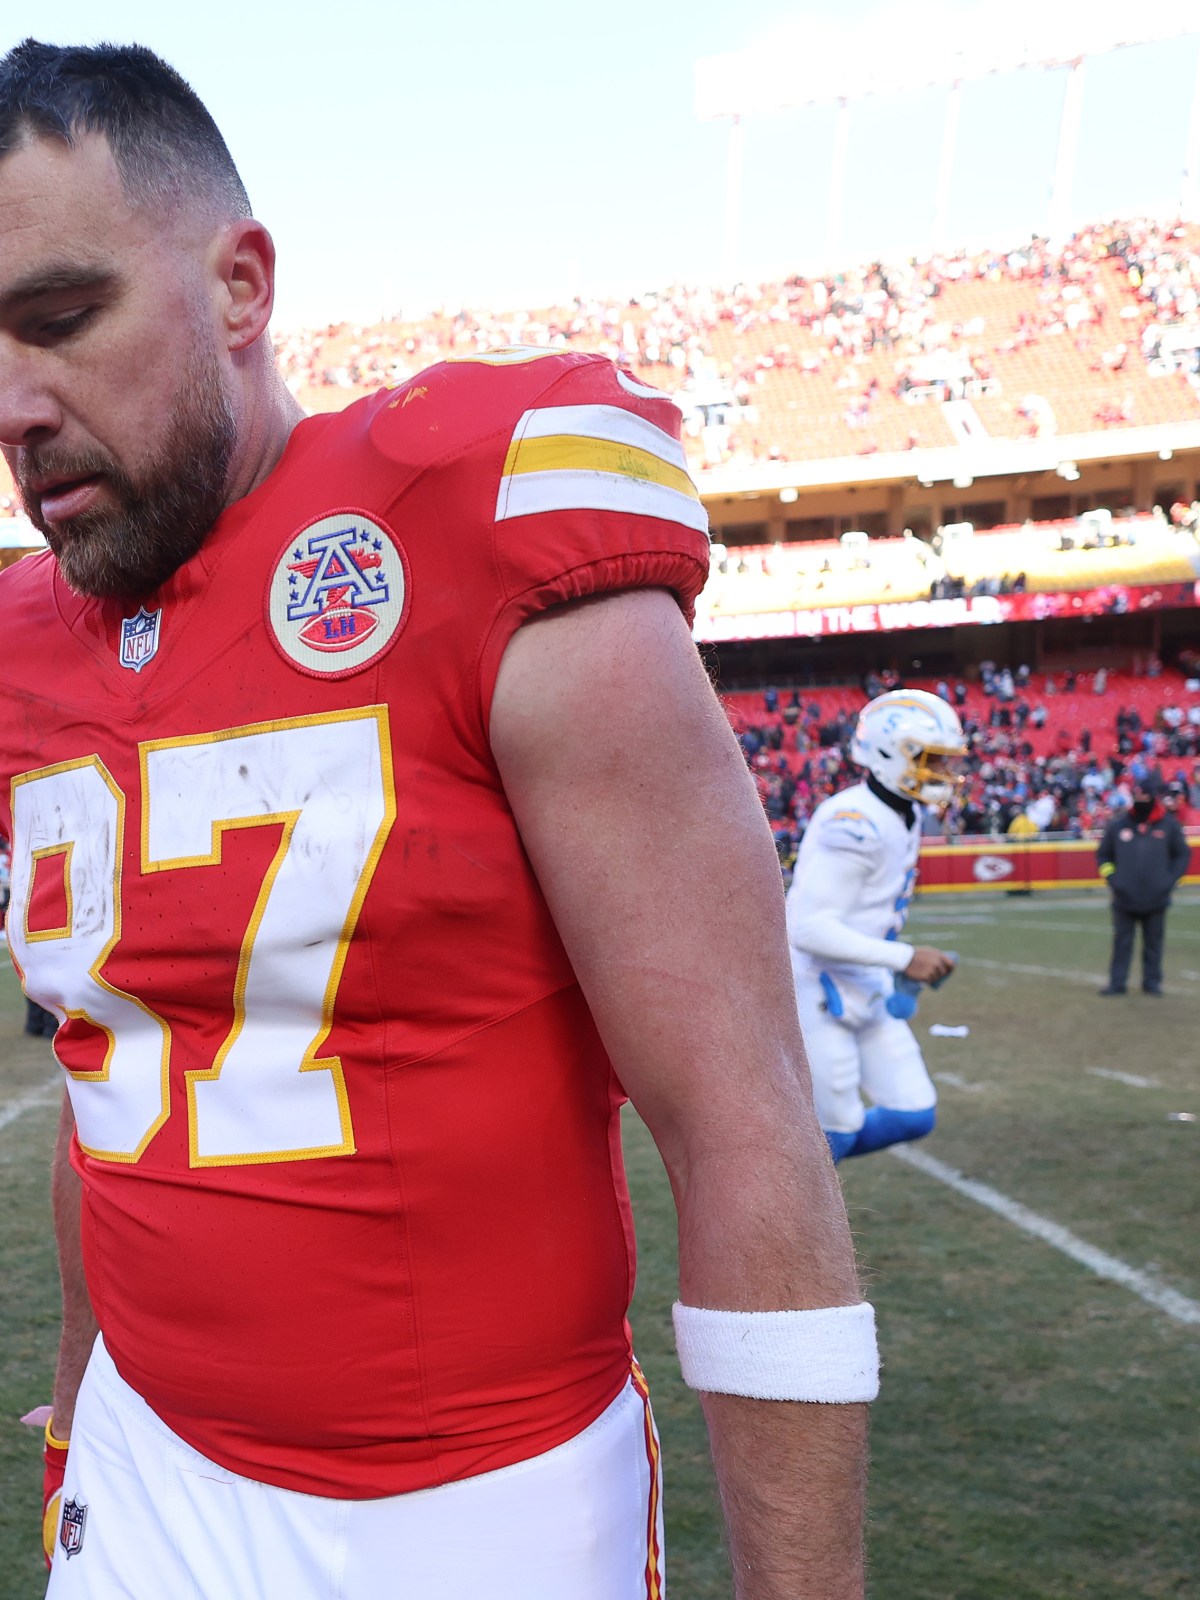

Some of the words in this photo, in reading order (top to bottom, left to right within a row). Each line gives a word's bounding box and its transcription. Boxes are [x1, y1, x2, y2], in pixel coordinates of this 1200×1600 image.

[322, 615, 357, 640] LH
[823, 606, 875, 631] THE
[125, 633, 151, 660] NFL
[5, 704, 397, 1168] 87
